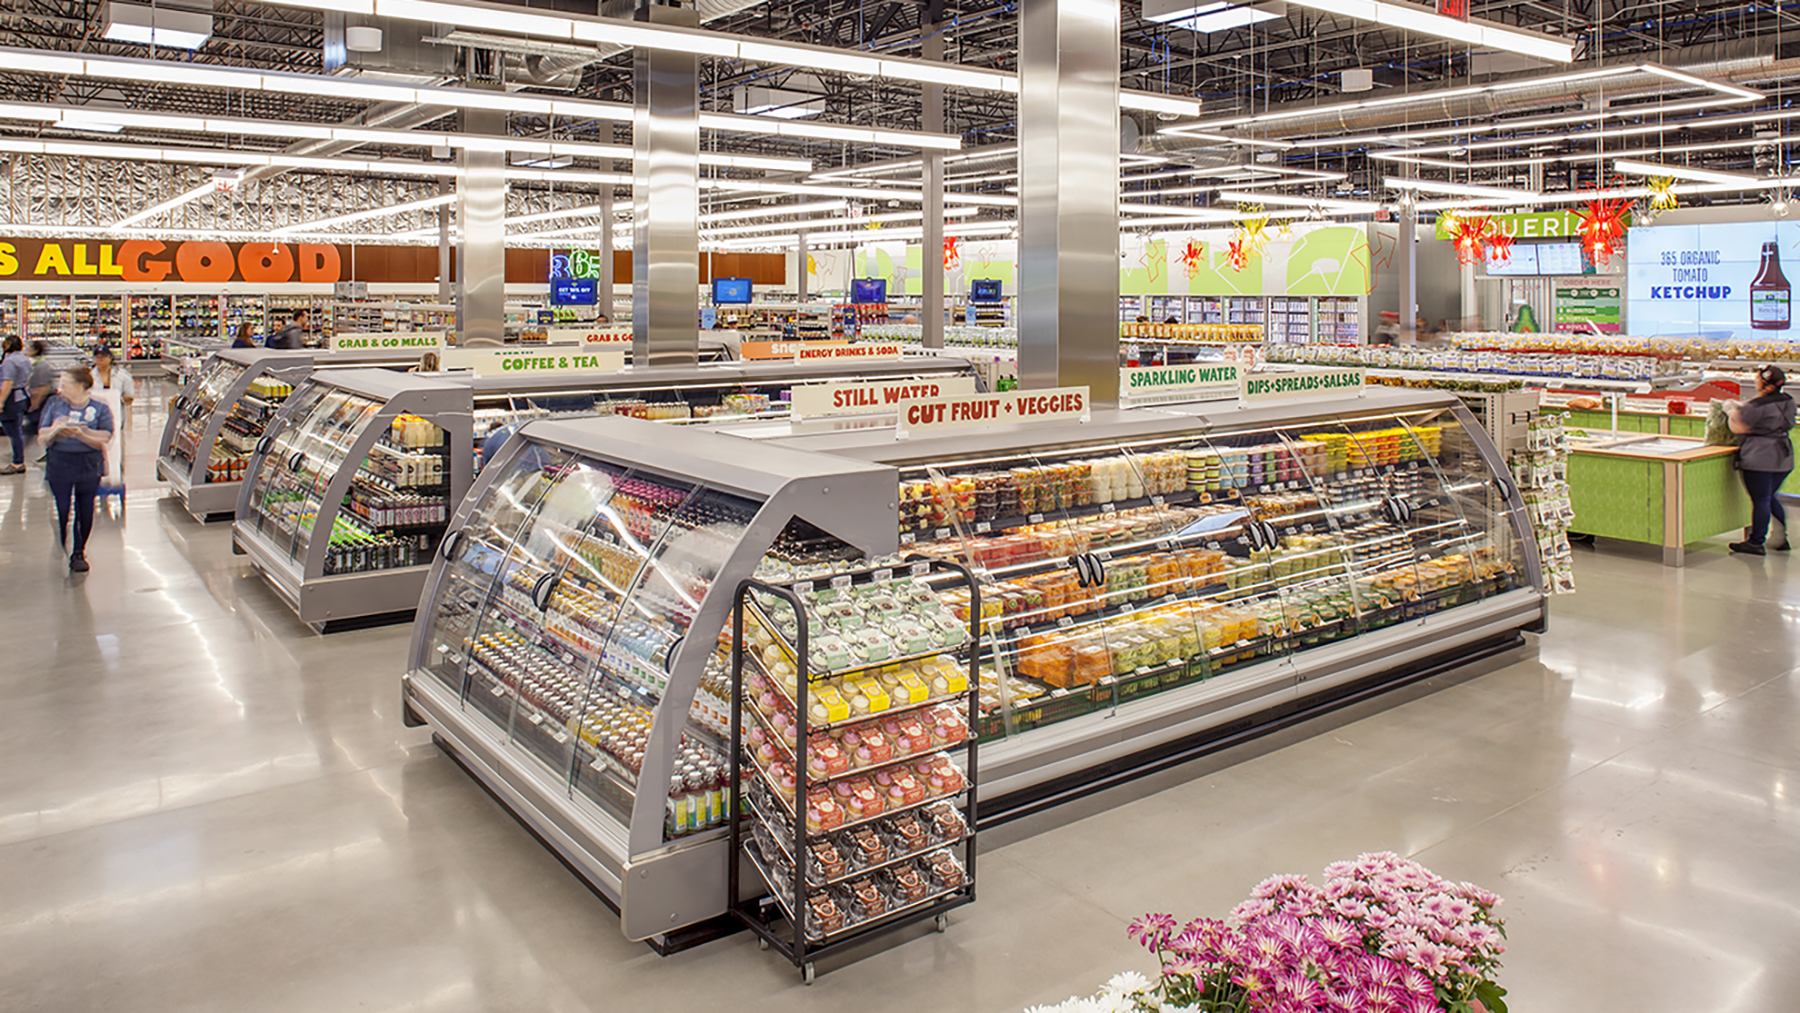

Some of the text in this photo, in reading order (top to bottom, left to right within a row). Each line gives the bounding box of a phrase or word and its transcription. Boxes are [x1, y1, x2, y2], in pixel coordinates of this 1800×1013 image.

[33, 243, 123, 275] ALL
[116, 239, 341, 283] GOOD
[1660, 250, 1721, 266] 365 ORGANIC
[1563, 278, 1612, 287] ORDER HERE
[1672, 267, 1708, 283] TOMATO
[1650, 285, 1732, 299] KETCHUP
[338, 337, 438, 349] GRAB & GO MEALS
[586, 333, 611, 343] GRAB
[613, 333, 620, 341] &
[799, 346, 899, 359] ENERGY DRINKS & SODA
[502, 356, 599, 371] COFFEE & TEA
[1130, 366, 1237, 387] SPARKLING WATER
[833, 384, 940, 408] STILL WATER
[907, 393, 1083, 425] CUT FRUIT + VEGGIES
